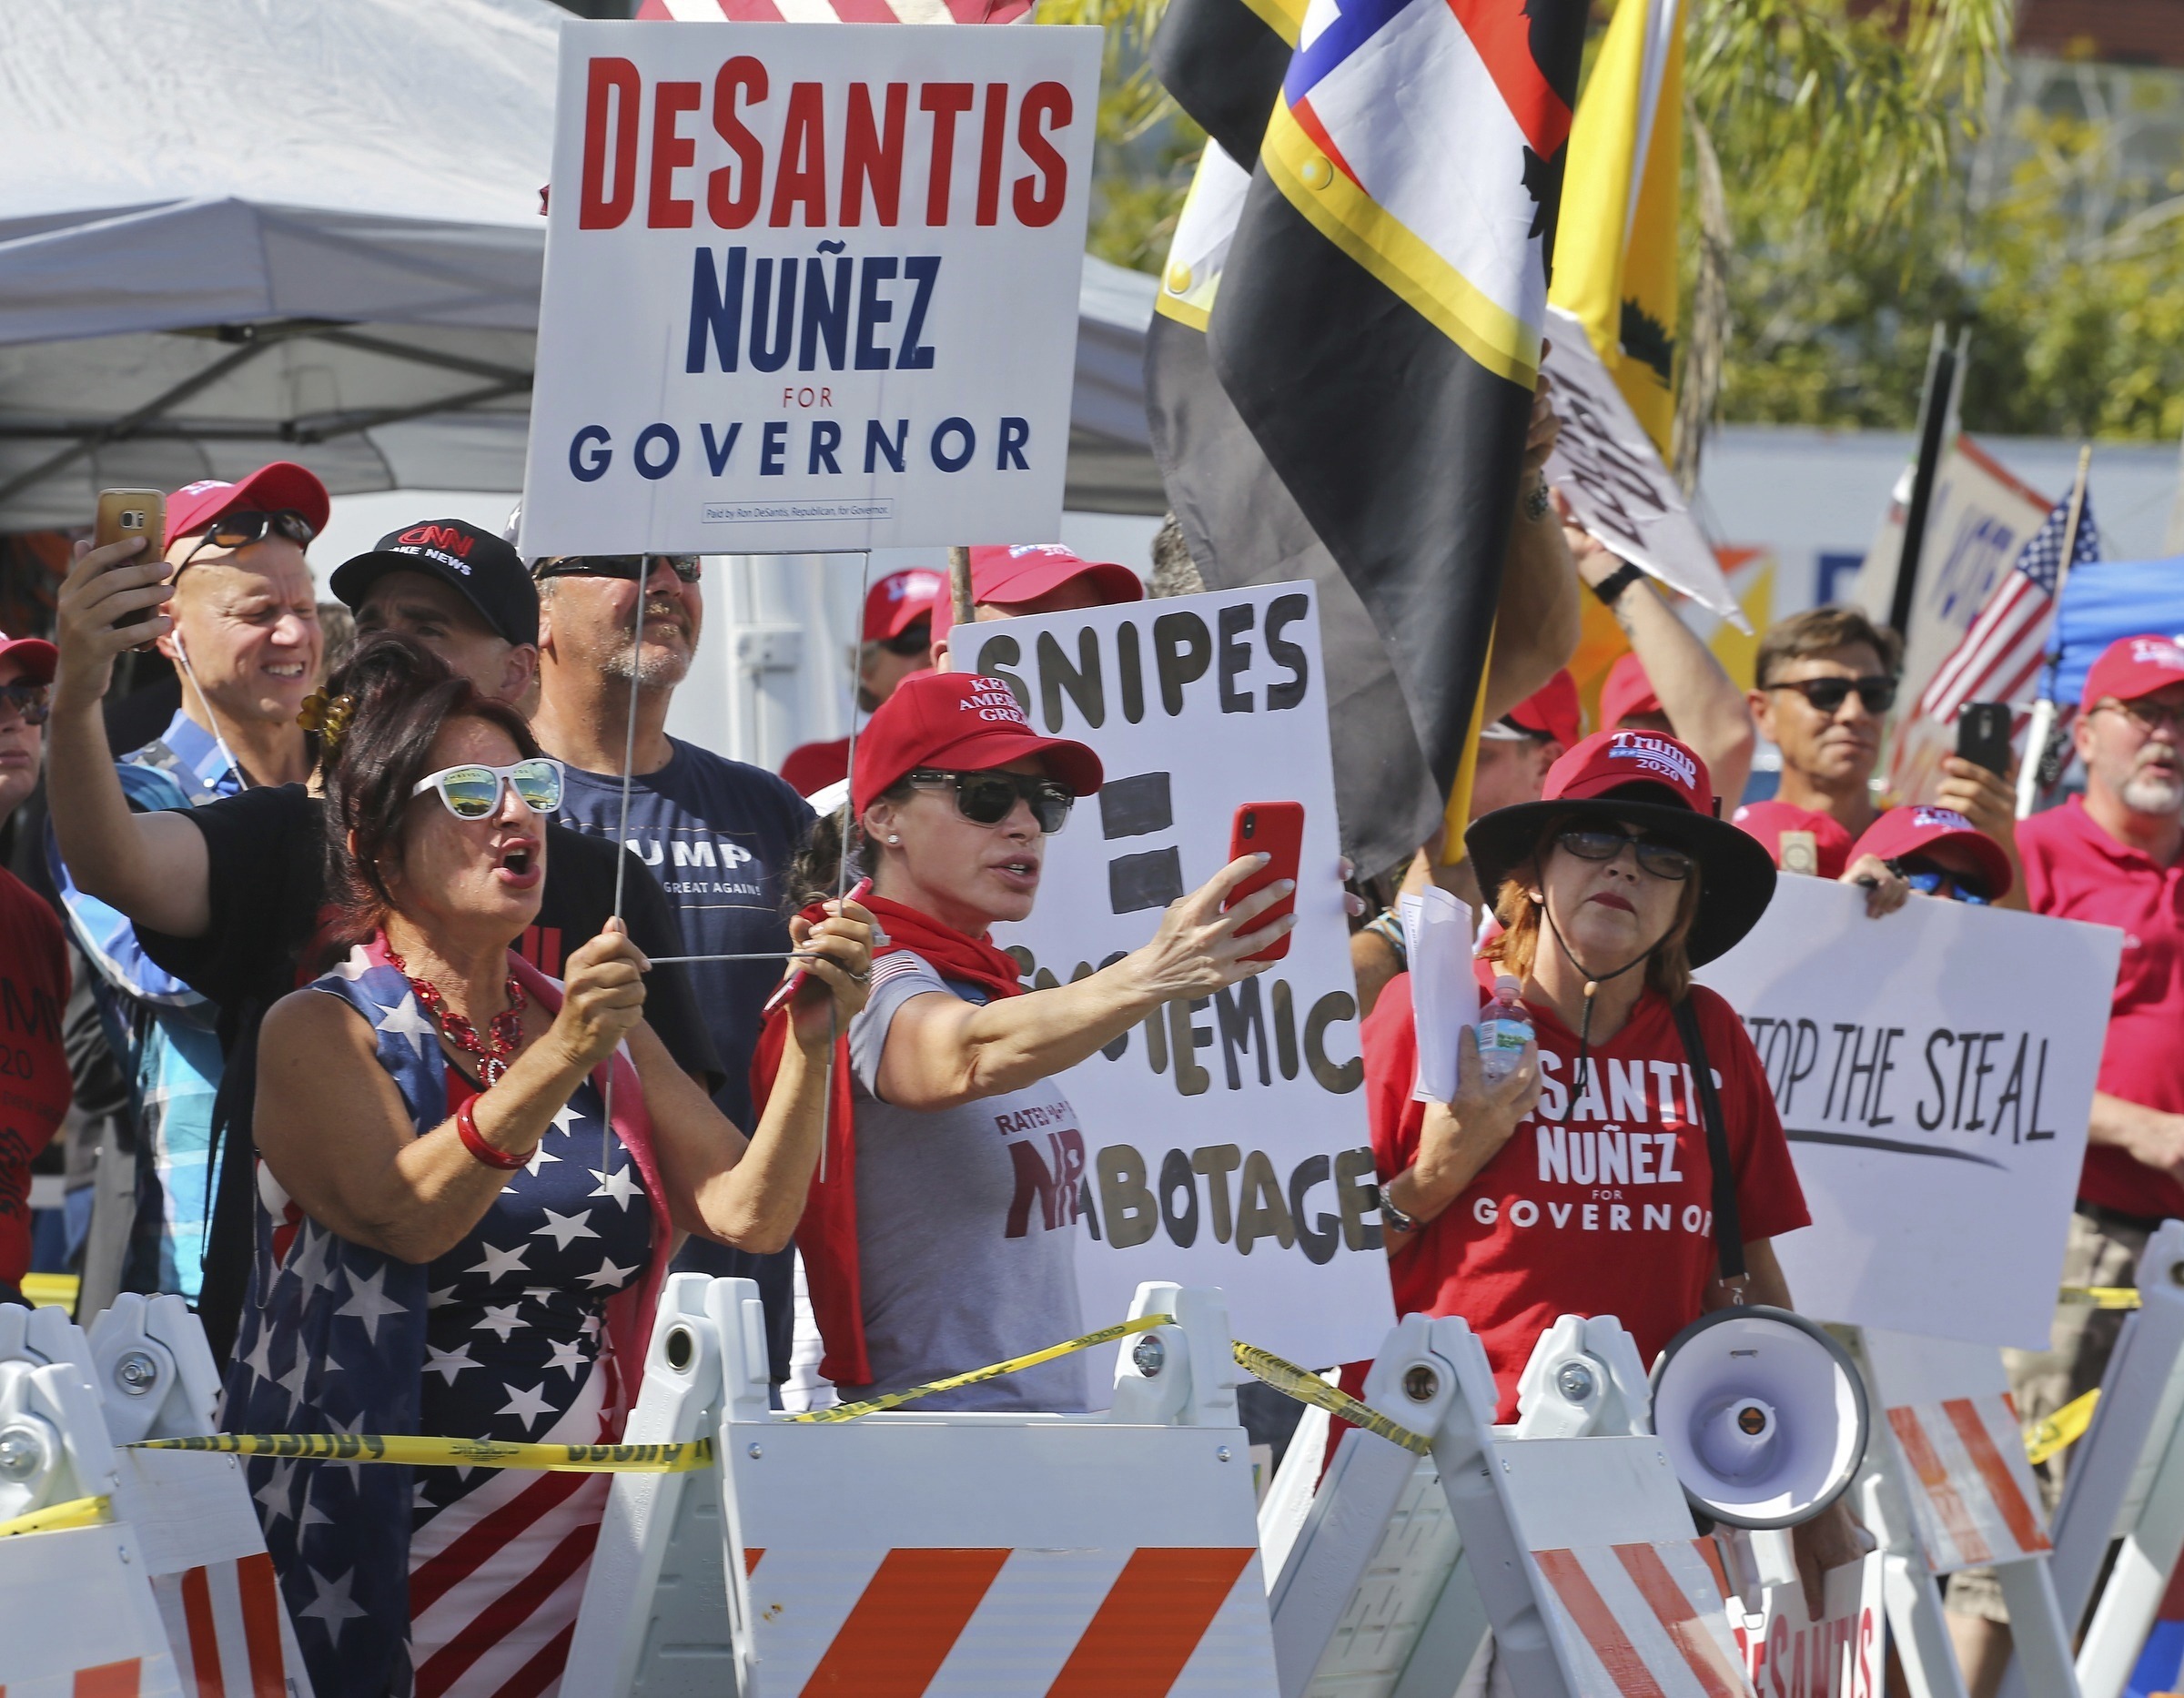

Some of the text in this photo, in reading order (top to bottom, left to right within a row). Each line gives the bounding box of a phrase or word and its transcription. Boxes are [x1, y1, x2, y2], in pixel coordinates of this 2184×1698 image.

[685, 239, 942, 373] NUÑEZ
[783, 387, 833, 408] FOR
[569, 417, 1031, 482] GOVERNOR
[706, 509, 723, 519] Paid
[725, 508, 734, 520] by
[737, 508, 752, 518] Ron
[837, 505, 849, 515] for
[398, 525, 475, 558] CNN
[389, 546, 472, 576] AKE NEWS
[976, 592, 1309, 733] SNIPES
[1609, 732, 1697, 776] Trump
[1635, 758, 1680, 782] 2020
[624, 838, 753, 869] UMP
[663, 882, 762, 896] GREAT AGAIN!
[1737, 1015, 2056, 1145] TOP THE STEAL
[1536, 1124, 1684, 1185] NUÑEZ
[1077, 1143, 1383, 1265] ABOTAGE
[1592, 1189, 1623, 1200] FOR
